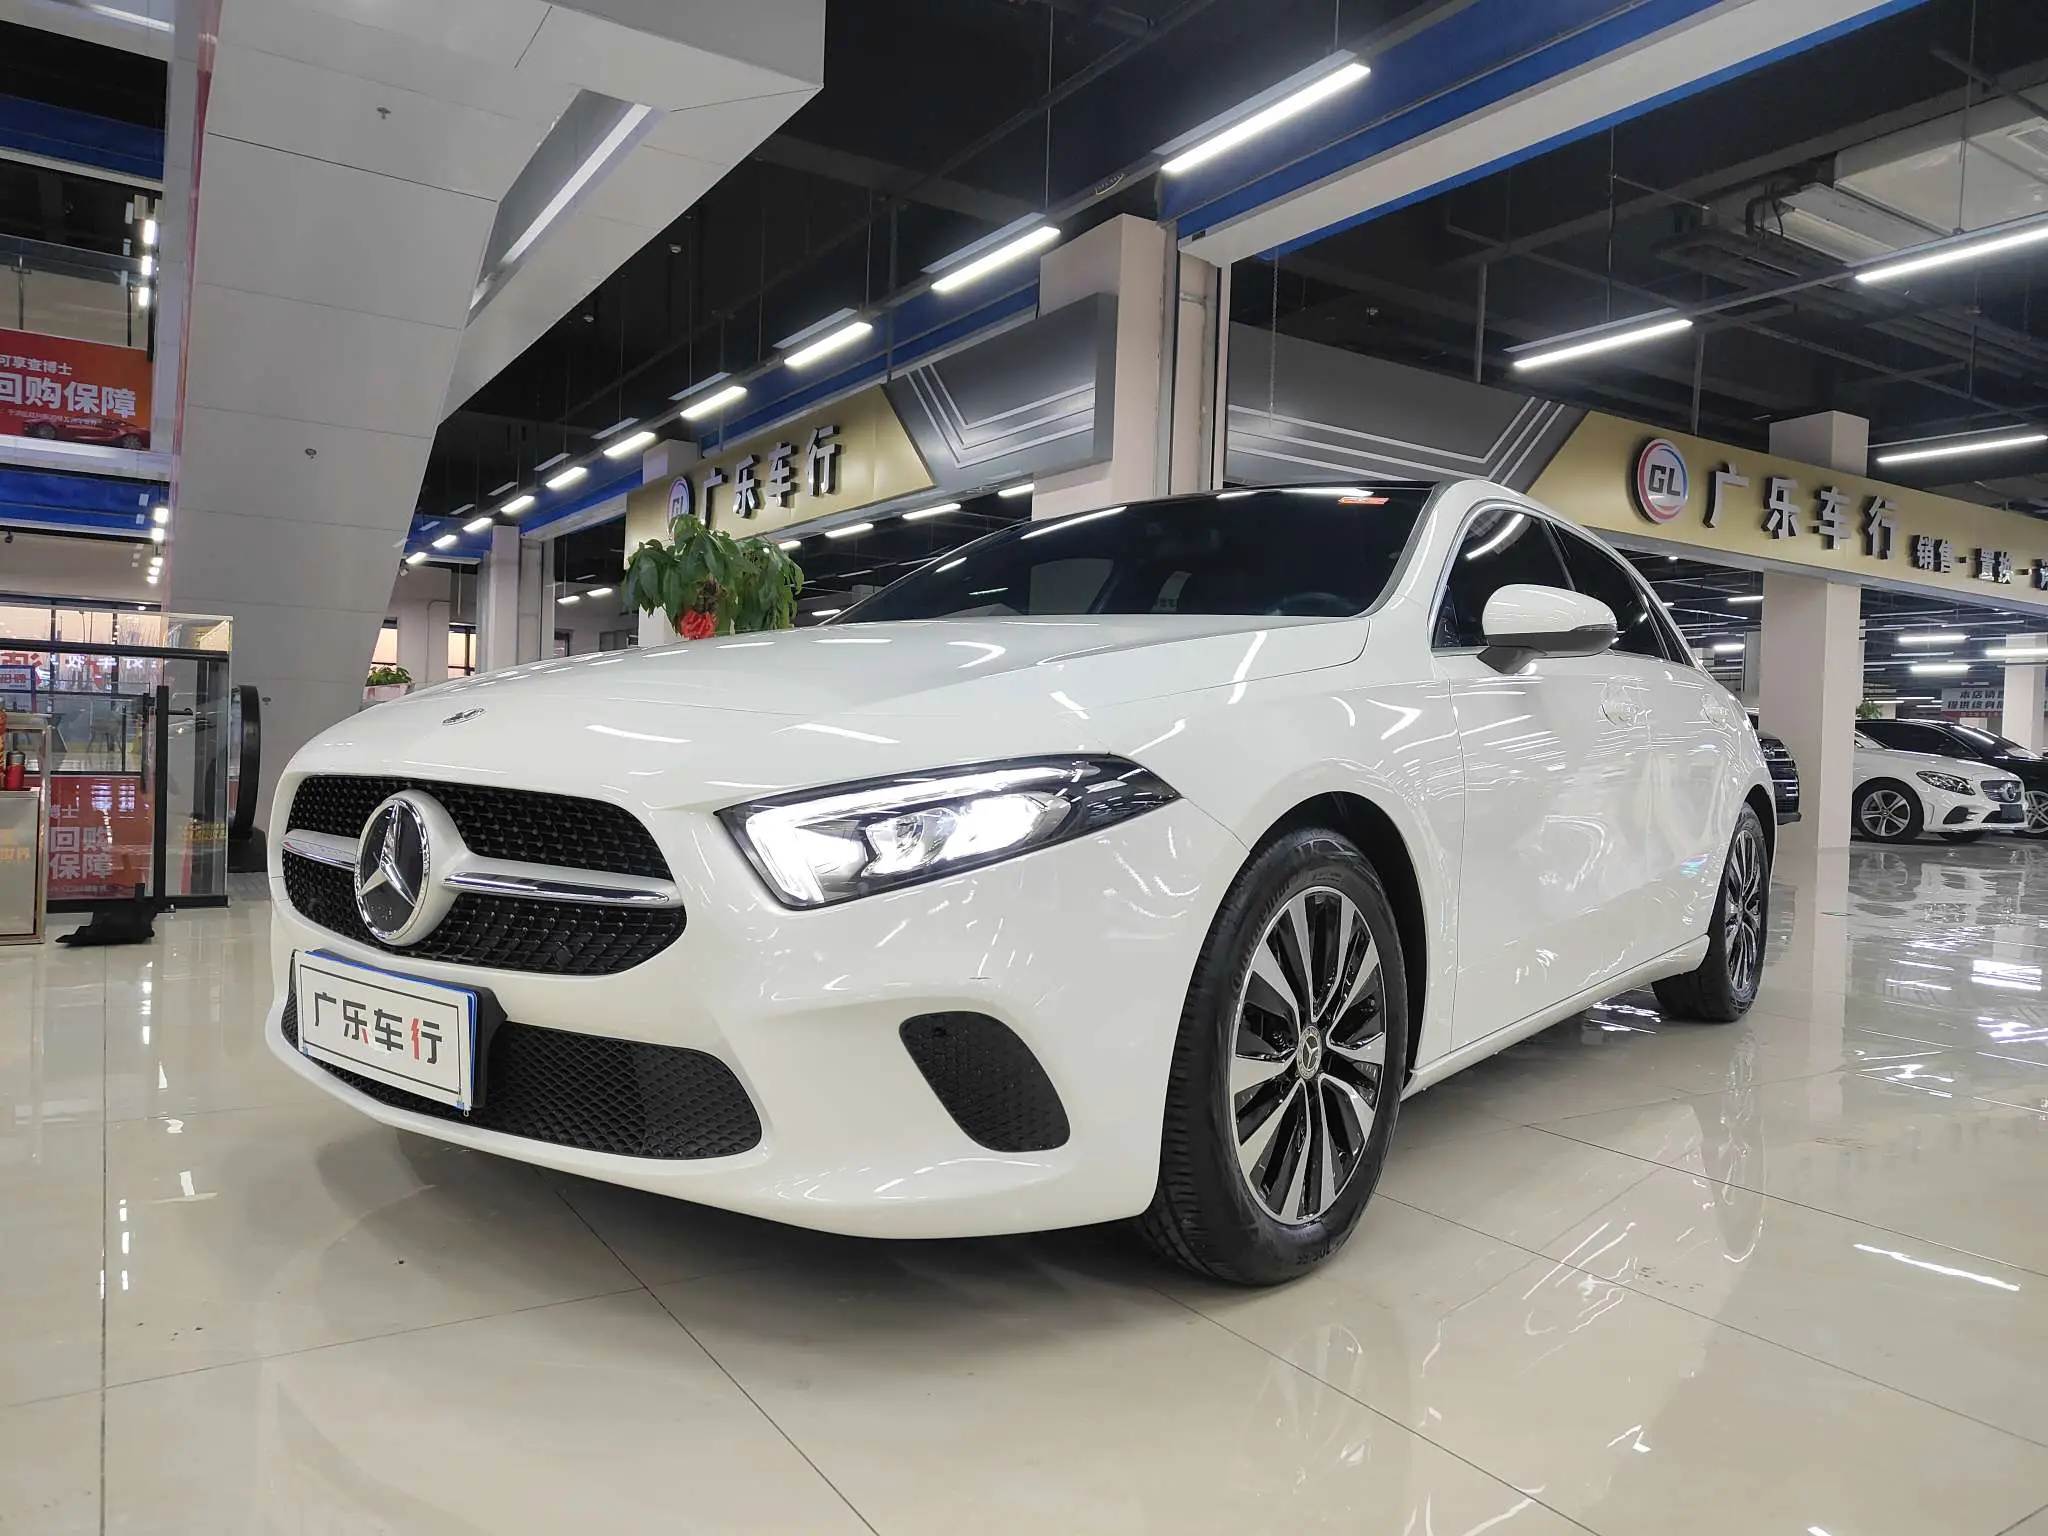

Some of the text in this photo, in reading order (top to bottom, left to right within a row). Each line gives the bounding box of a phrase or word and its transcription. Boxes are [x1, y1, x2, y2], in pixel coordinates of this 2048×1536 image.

[0, 371, 136, 418] 回购保障
[701, 424, 841, 529] 广乐车行
[1647, 463, 1682, 497] GL
[1703, 460, 1899, 561] 广乐车行
[50, 853, 113, 879] 保障
[313, 991, 443, 1065] 广乐车行
